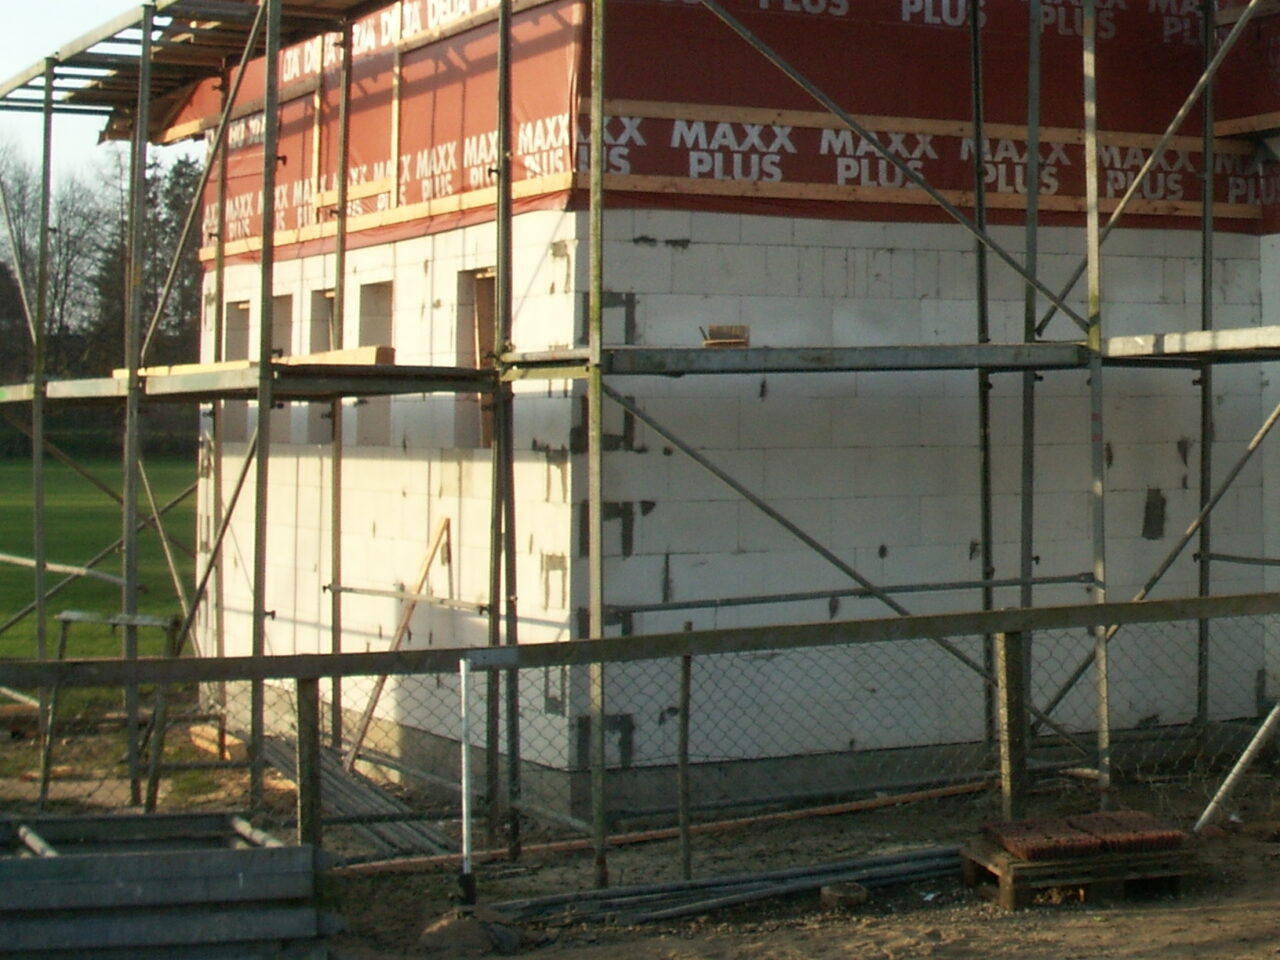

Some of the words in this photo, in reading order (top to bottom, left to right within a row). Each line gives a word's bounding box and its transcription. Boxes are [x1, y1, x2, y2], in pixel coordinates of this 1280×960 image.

[416, 141, 457, 180] MAXX
[517, 113, 569, 156] MAXX
[671, 120, 797, 154] MAXX
[819, 129, 939, 160] MAXX
[690, 151, 783, 182] PLUS
[836, 157, 926, 190] PLUS
